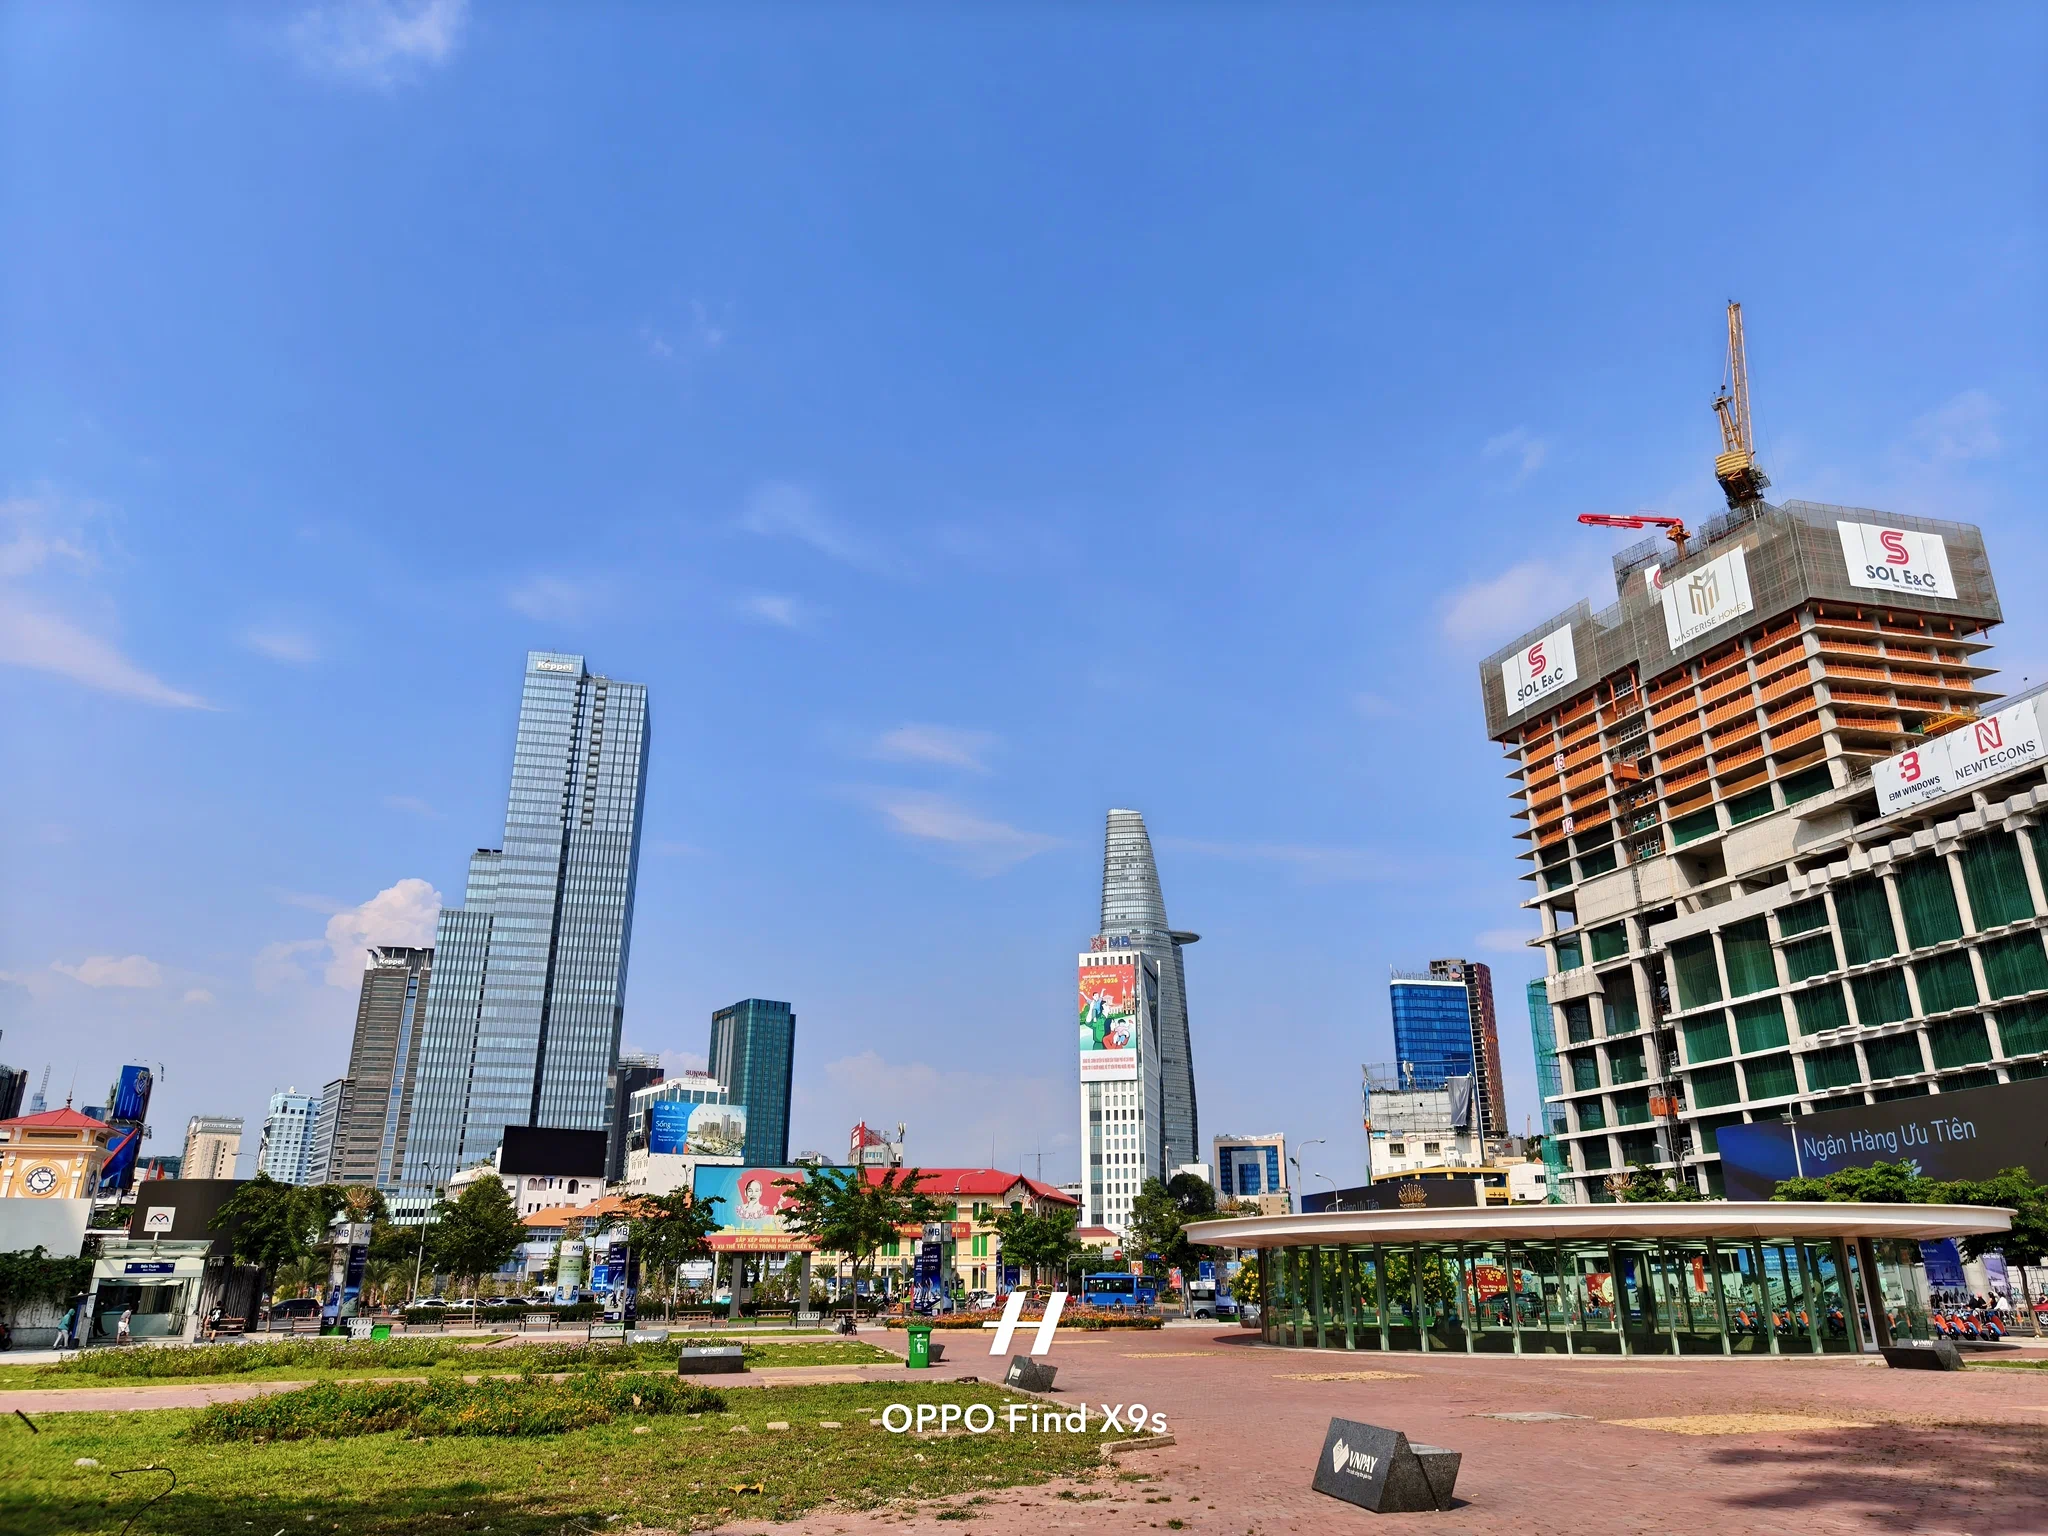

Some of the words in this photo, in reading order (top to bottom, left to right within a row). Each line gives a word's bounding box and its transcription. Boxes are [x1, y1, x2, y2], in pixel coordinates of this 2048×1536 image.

[1866, 564, 1900, 583] SOL
[1902, 569, 1936, 588] E&C
[1674, 616, 1717, 644] MASTERISE
[1717, 601, 1747, 622] HOMES
[537, 660, 573, 671] Keppel
[1517, 680, 1540, 702] SOL
[1541, 667, 1564, 689] E&C
[1954, 740, 2036, 780] NEWTECONS
[1888, 790, 1902, 802] BM
[1901, 775, 1941, 797] WINDOWS
[1108, 936, 1131, 948] MB
[1396, 969, 1449, 981] VietinBank
[1803, 1134, 1847, 1162] Ngân
[1850, 1129, 1899, 1153] Hàng
[1900, 1122, 1929, 1147] Ưu
[1930, 1117, 1977, 1143] Tiên
[335, 1229, 349, 1238] MB
[616, 1227, 628, 1236] MB
[928, 1228, 940, 1236] MB
[1349, 1450, 1378, 1474] VNPAY
